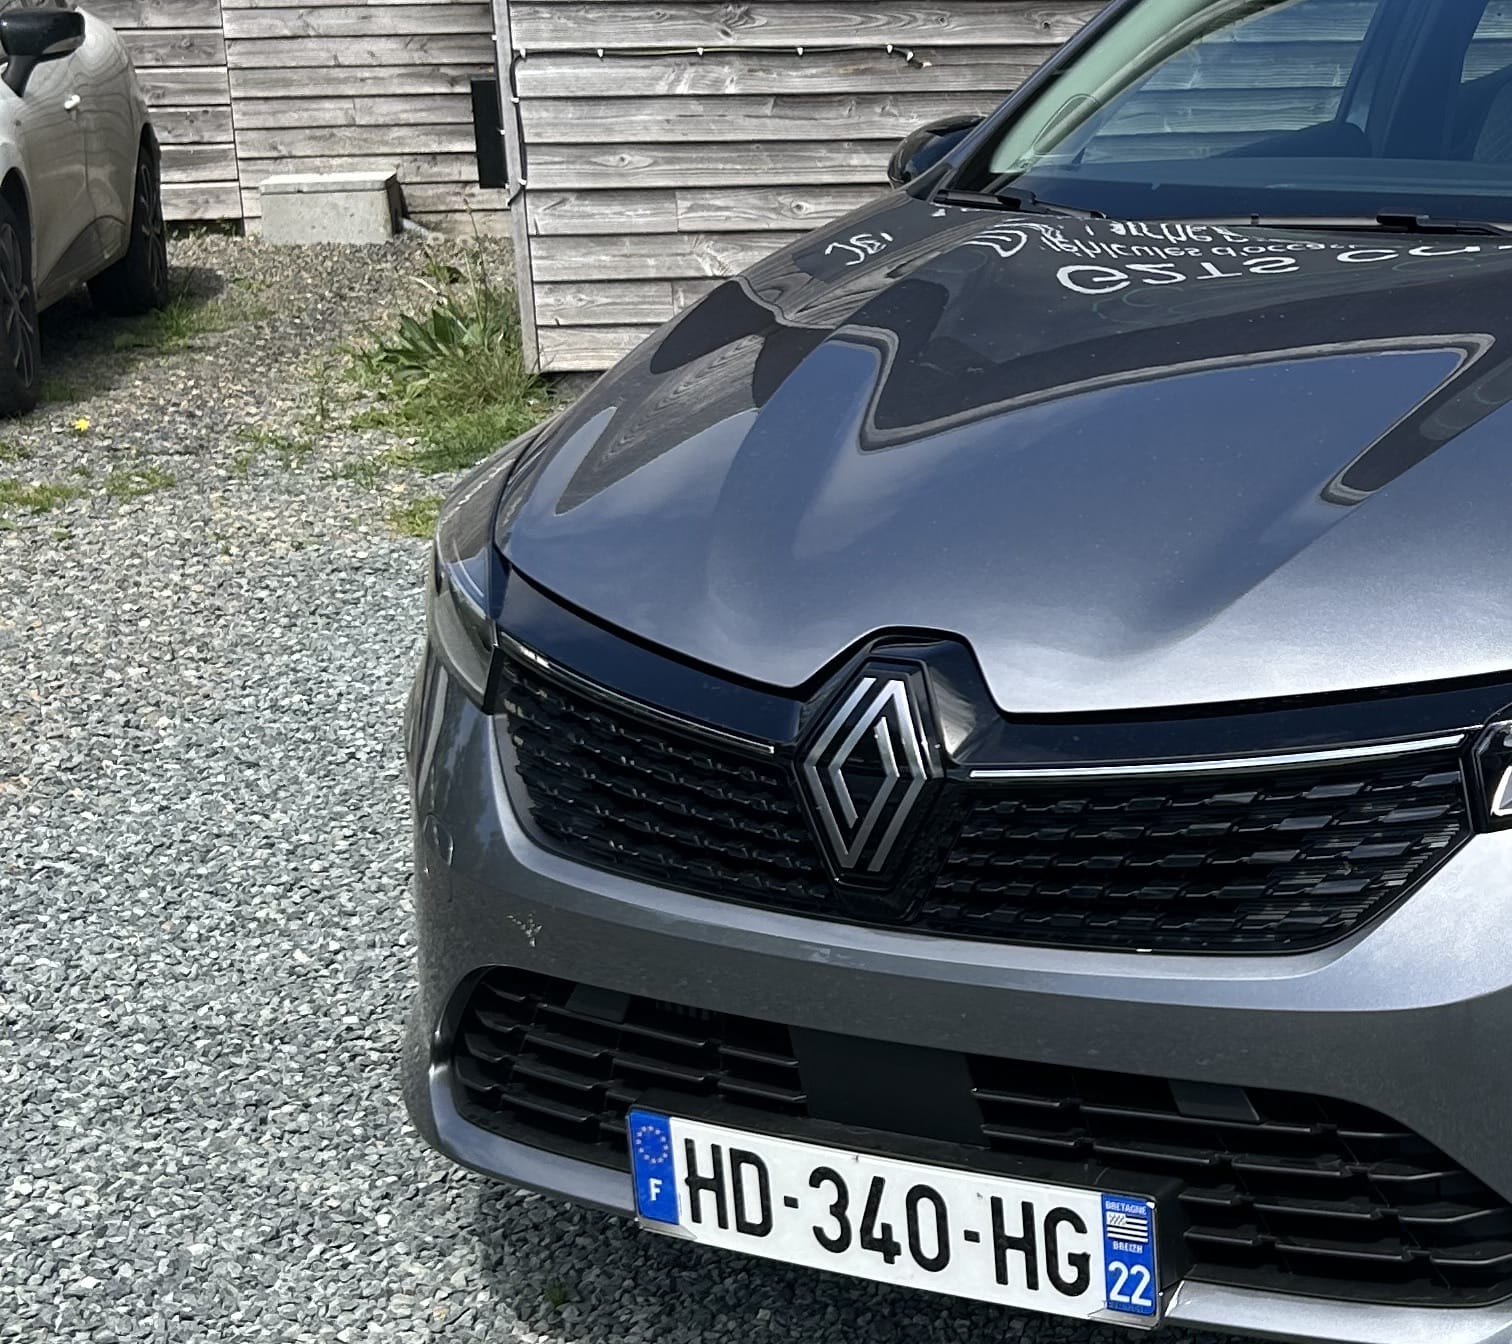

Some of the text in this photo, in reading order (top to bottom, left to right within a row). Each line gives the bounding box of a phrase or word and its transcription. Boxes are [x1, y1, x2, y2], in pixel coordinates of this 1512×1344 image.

[649, 1177, 663, 1201] F
[684, 1137, 1092, 1298] HD-340-HG
[1108, 1260, 1152, 1307] 22
